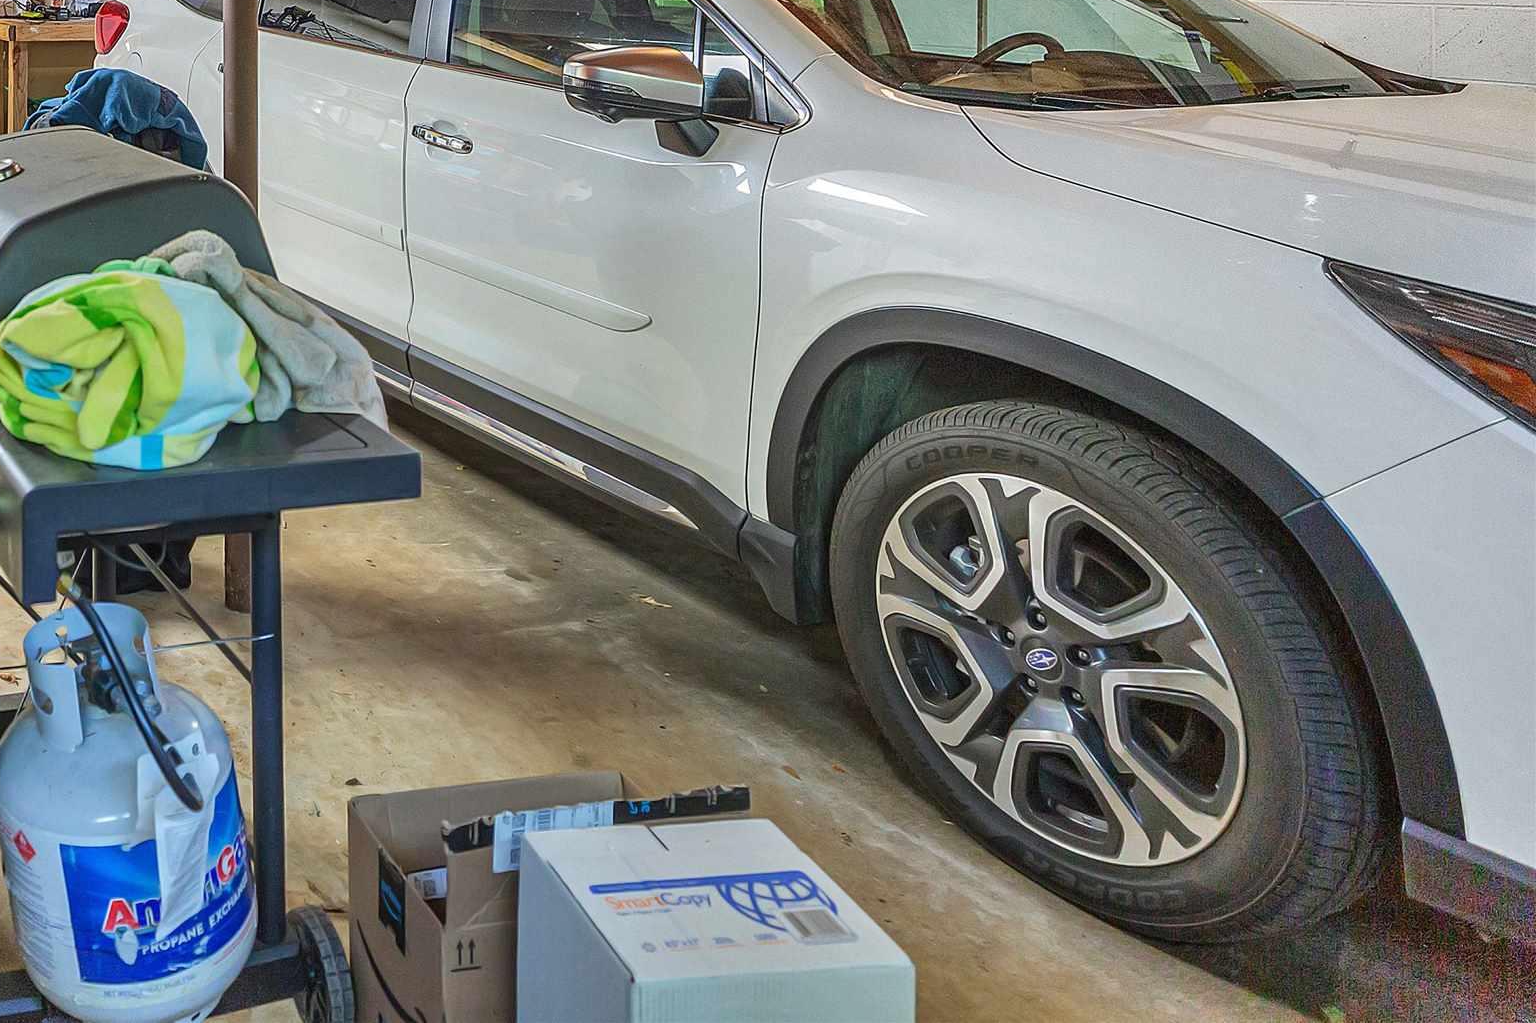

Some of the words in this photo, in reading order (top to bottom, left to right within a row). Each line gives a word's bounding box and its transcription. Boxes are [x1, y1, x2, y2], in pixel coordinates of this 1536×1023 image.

[906, 445, 1040, 470] COOPER
[604, 892, 712, 910] SmartCopy
[141, 923, 205, 956] PROPANE
